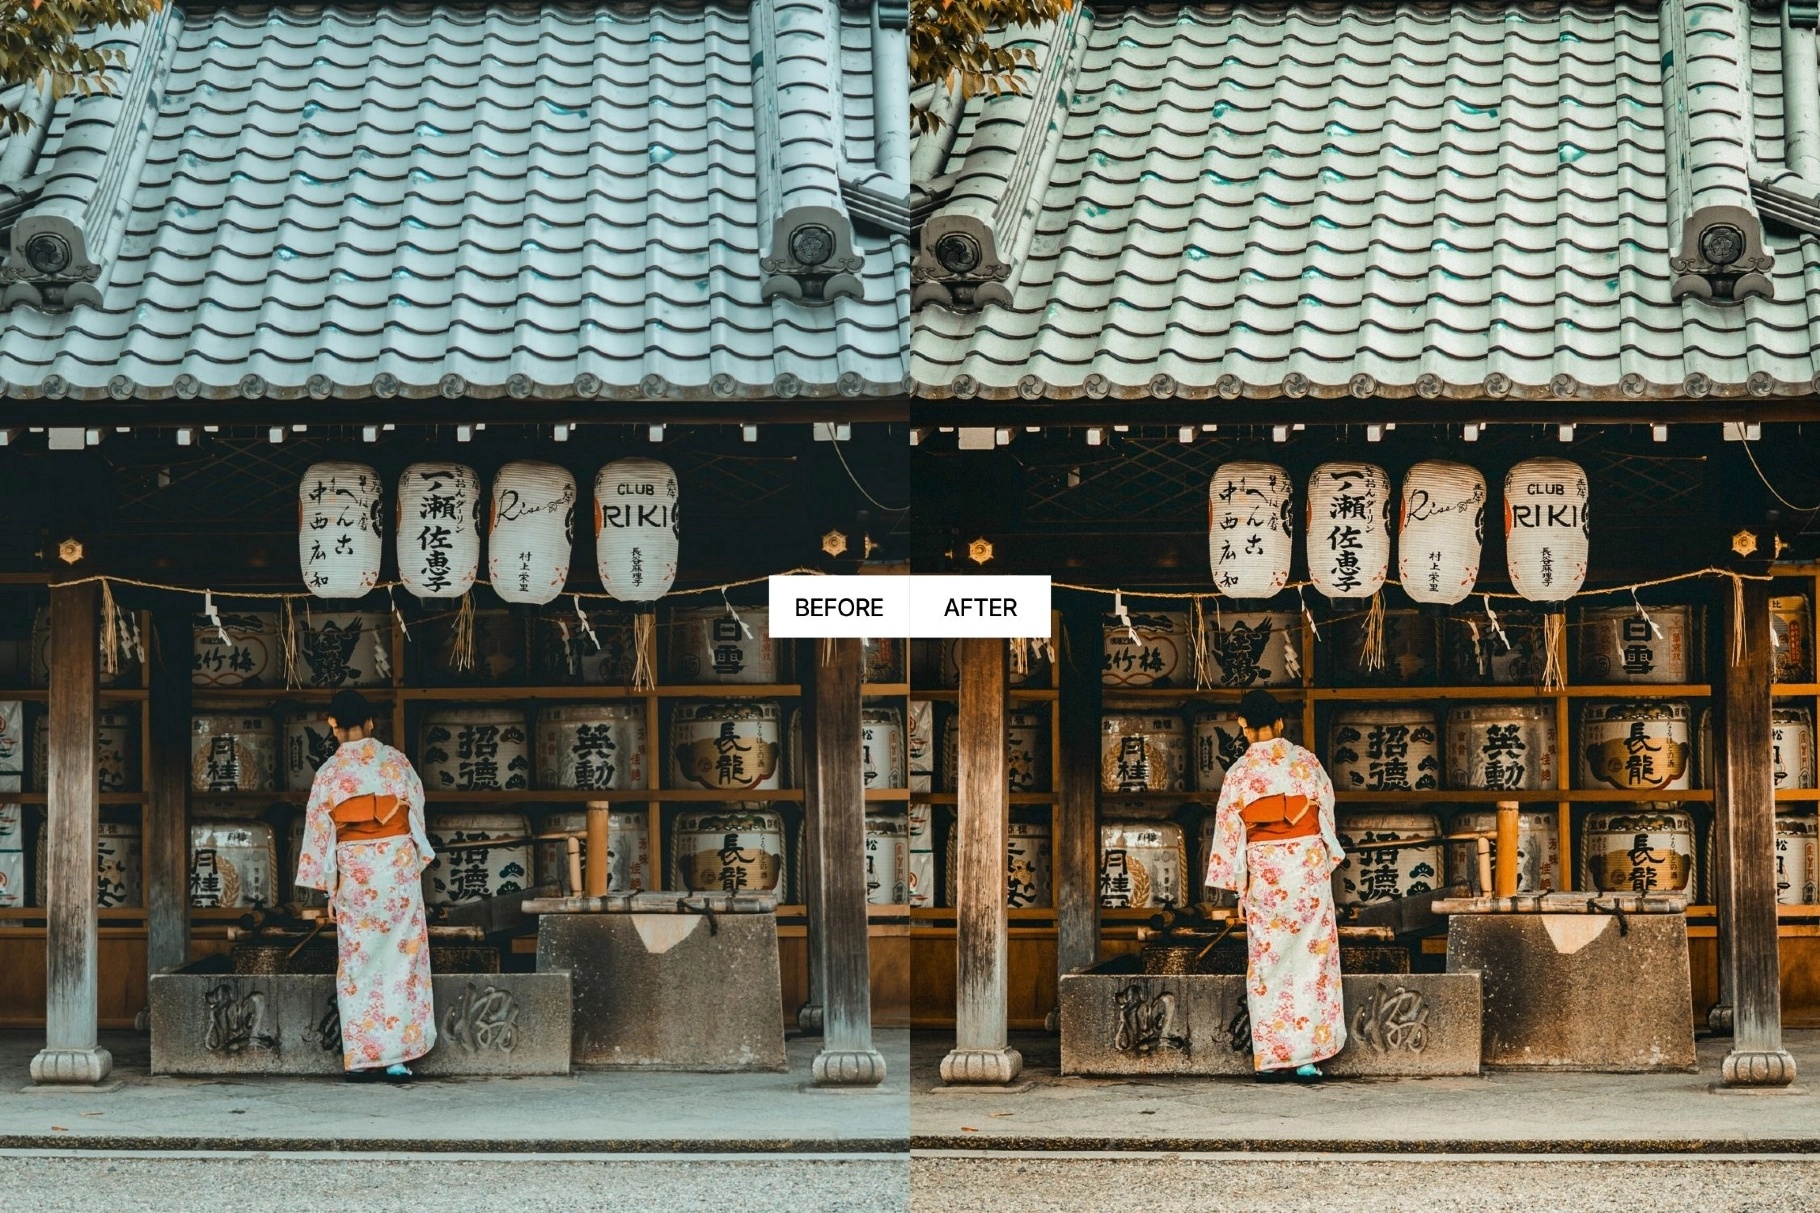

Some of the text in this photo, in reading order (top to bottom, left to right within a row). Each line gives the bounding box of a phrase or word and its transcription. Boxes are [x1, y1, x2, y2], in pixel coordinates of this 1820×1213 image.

[602, 505, 666, 528] RIKI
[617, 484, 655, 495] CLUB
[1512, 505, 1576, 528] RIKI
[1527, 484, 1565, 495] CLUB
[417, 471, 456, 592] 一ノ瀬佐恵子
[1327, 471, 1366, 592] 一ノ瀬佐恵子
[712, 616, 746, 674] 白雪
[1622, 616, 1656, 674] 白雪
[713, 722, 752, 786] 長龍
[1623, 722, 1662, 786] 長龍
